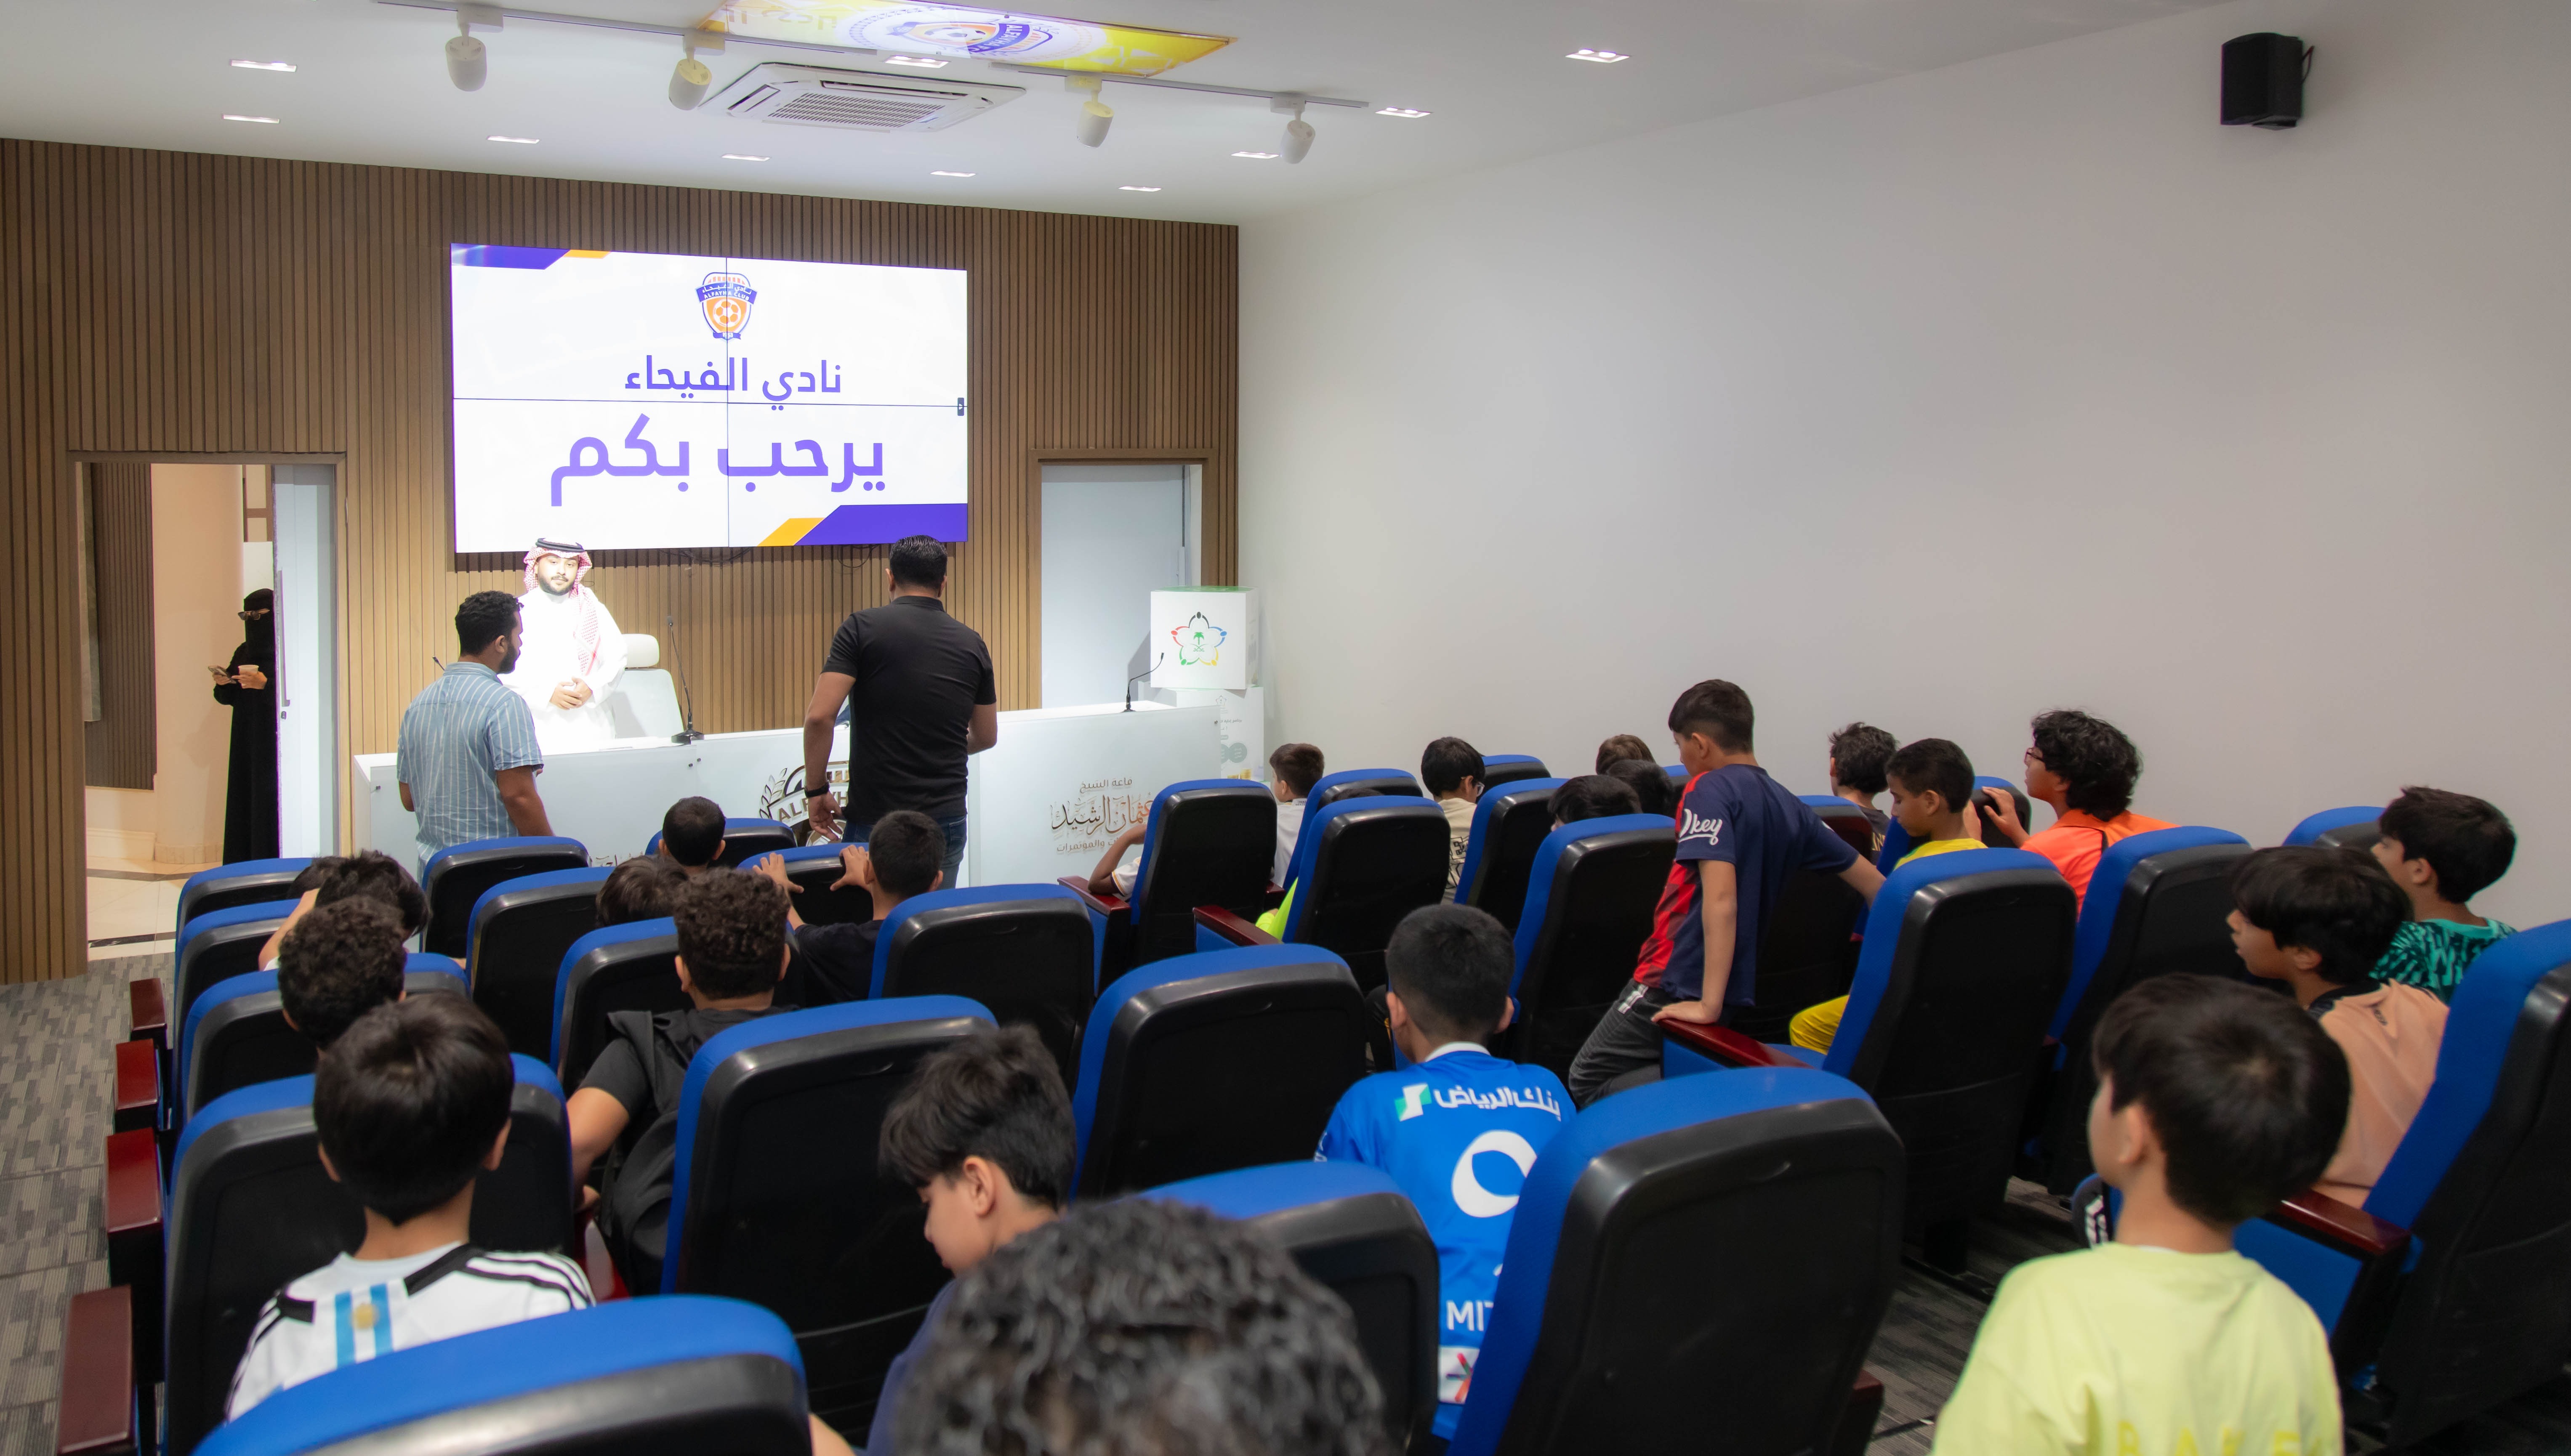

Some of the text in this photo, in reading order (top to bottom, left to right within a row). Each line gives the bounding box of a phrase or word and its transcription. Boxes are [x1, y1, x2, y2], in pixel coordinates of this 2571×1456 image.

[987, 24, 1023, 46] ALFAYHA
[704, 290, 750, 301] ALFAYHA CLUB
[625, 355, 841, 411] نادي الفيحاء
[551, 413, 886, 507] يرحب بكم
[1433, 1084, 1561, 1121] بنك الرياض
